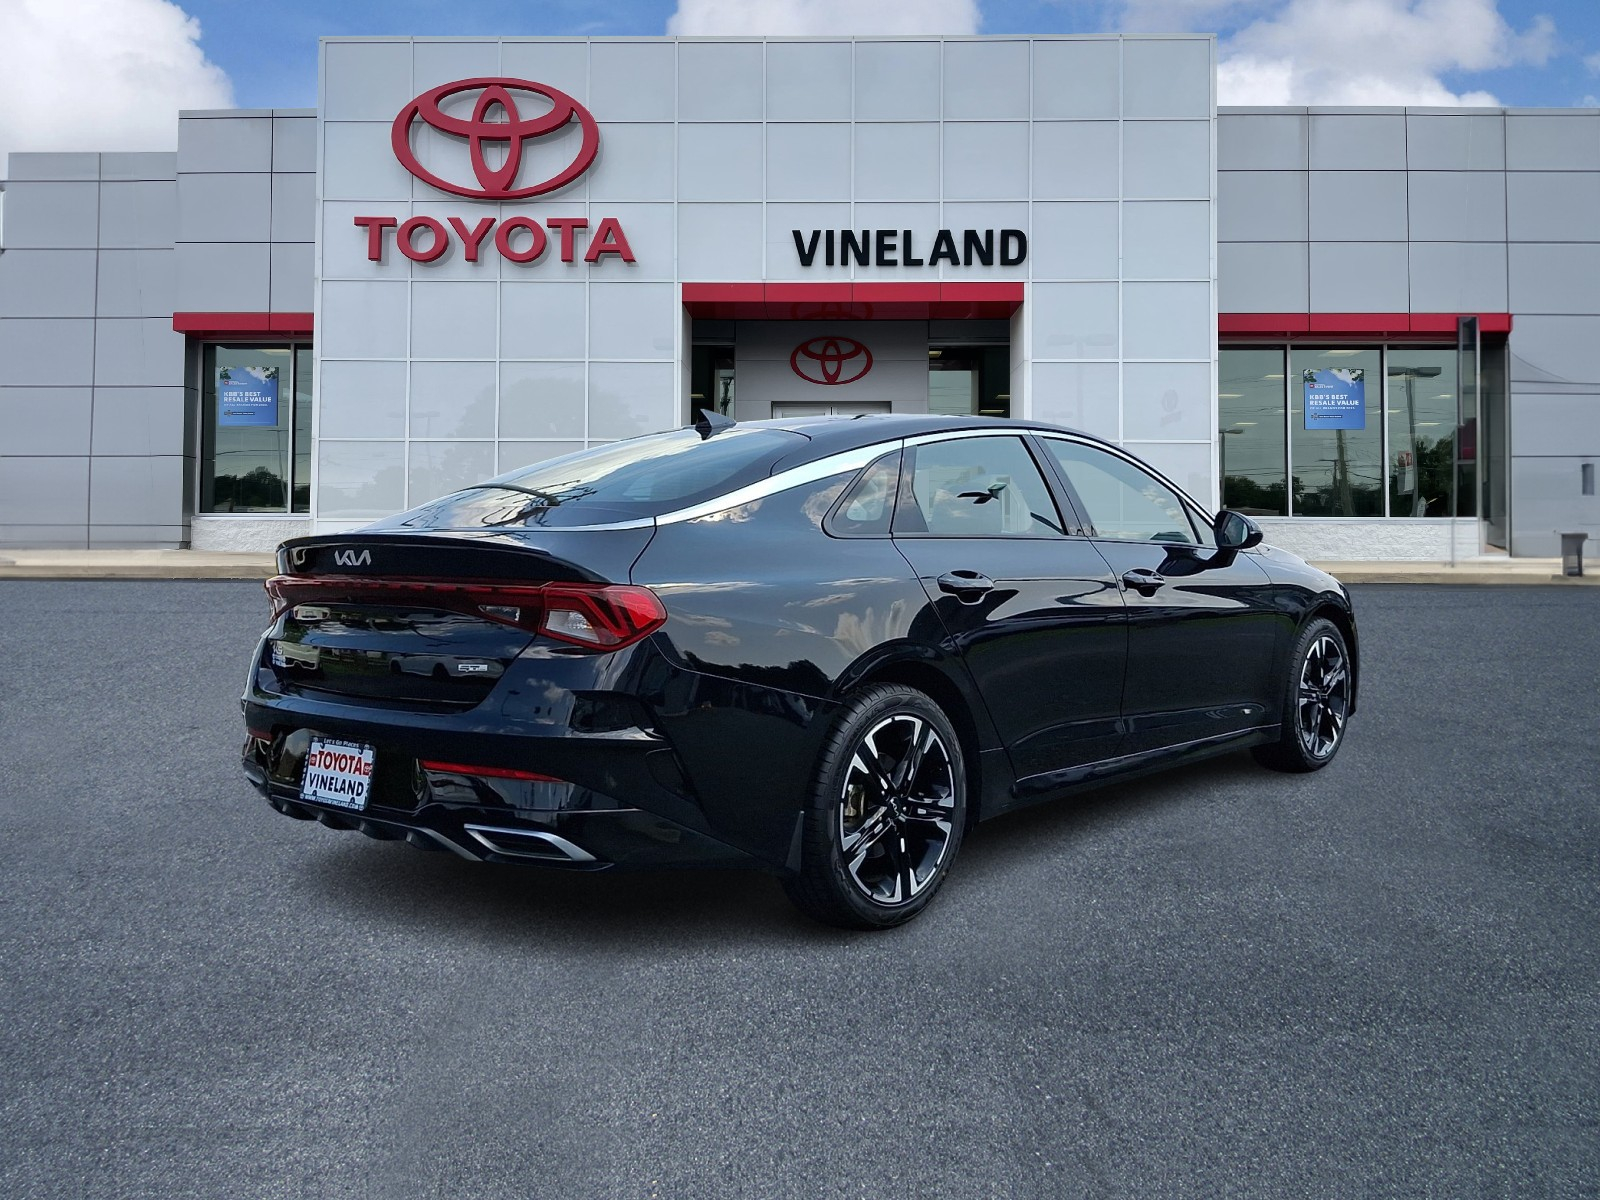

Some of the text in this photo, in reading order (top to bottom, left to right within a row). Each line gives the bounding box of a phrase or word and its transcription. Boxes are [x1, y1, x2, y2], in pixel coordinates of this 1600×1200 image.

[354, 216, 636, 263] TOYOTA
[792, 229, 1028, 266] VINELAND
[334, 550, 371, 566] KIA
[317, 750, 362, 775] TOYOTA
[309, 772, 364, 797] VINELAND
